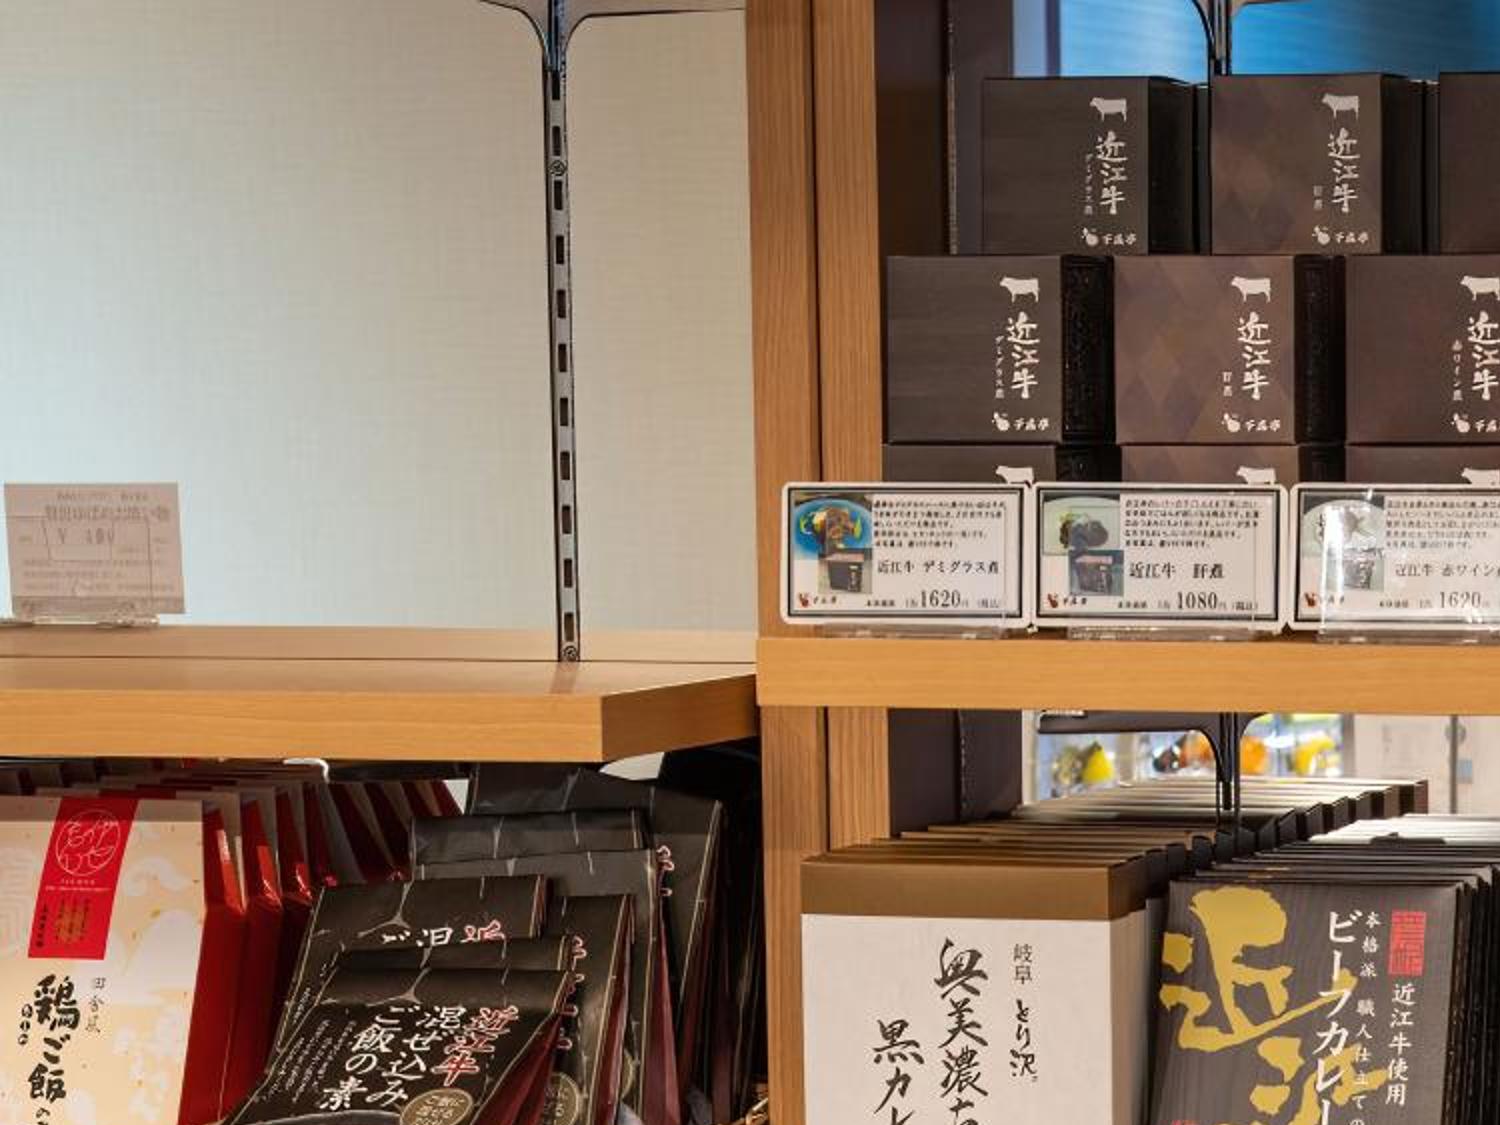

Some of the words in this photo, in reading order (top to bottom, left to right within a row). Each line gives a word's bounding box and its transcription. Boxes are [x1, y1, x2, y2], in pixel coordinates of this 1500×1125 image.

[1096, 130, 1127, 215] 近江牛
[1327, 128, 1360, 213] 近江牛
[1007, 311, 1040, 400] 近江牛
[1237, 311, 1271, 400] 近江牛
[1468, 310, 1500, 401] 近江牛
[878, 560, 915, 574] 近江牛
[922, 560, 999, 574] デミグラス煮
[1130, 564, 1175, 578] 近江牛
[1396, 564, 1432, 576] 近江牛
[1013, 943, 1033, 985] 岐阜
[1360, 912, 1381, 977] 本格派
[319, 1005, 420, 1111] ご飯の素
[366, 1005, 467, 1108] 混ぜ込み
[430, 1005, 520, 1087] 近江牛
[1385, 984, 1415, 1107] 近江牛使用
